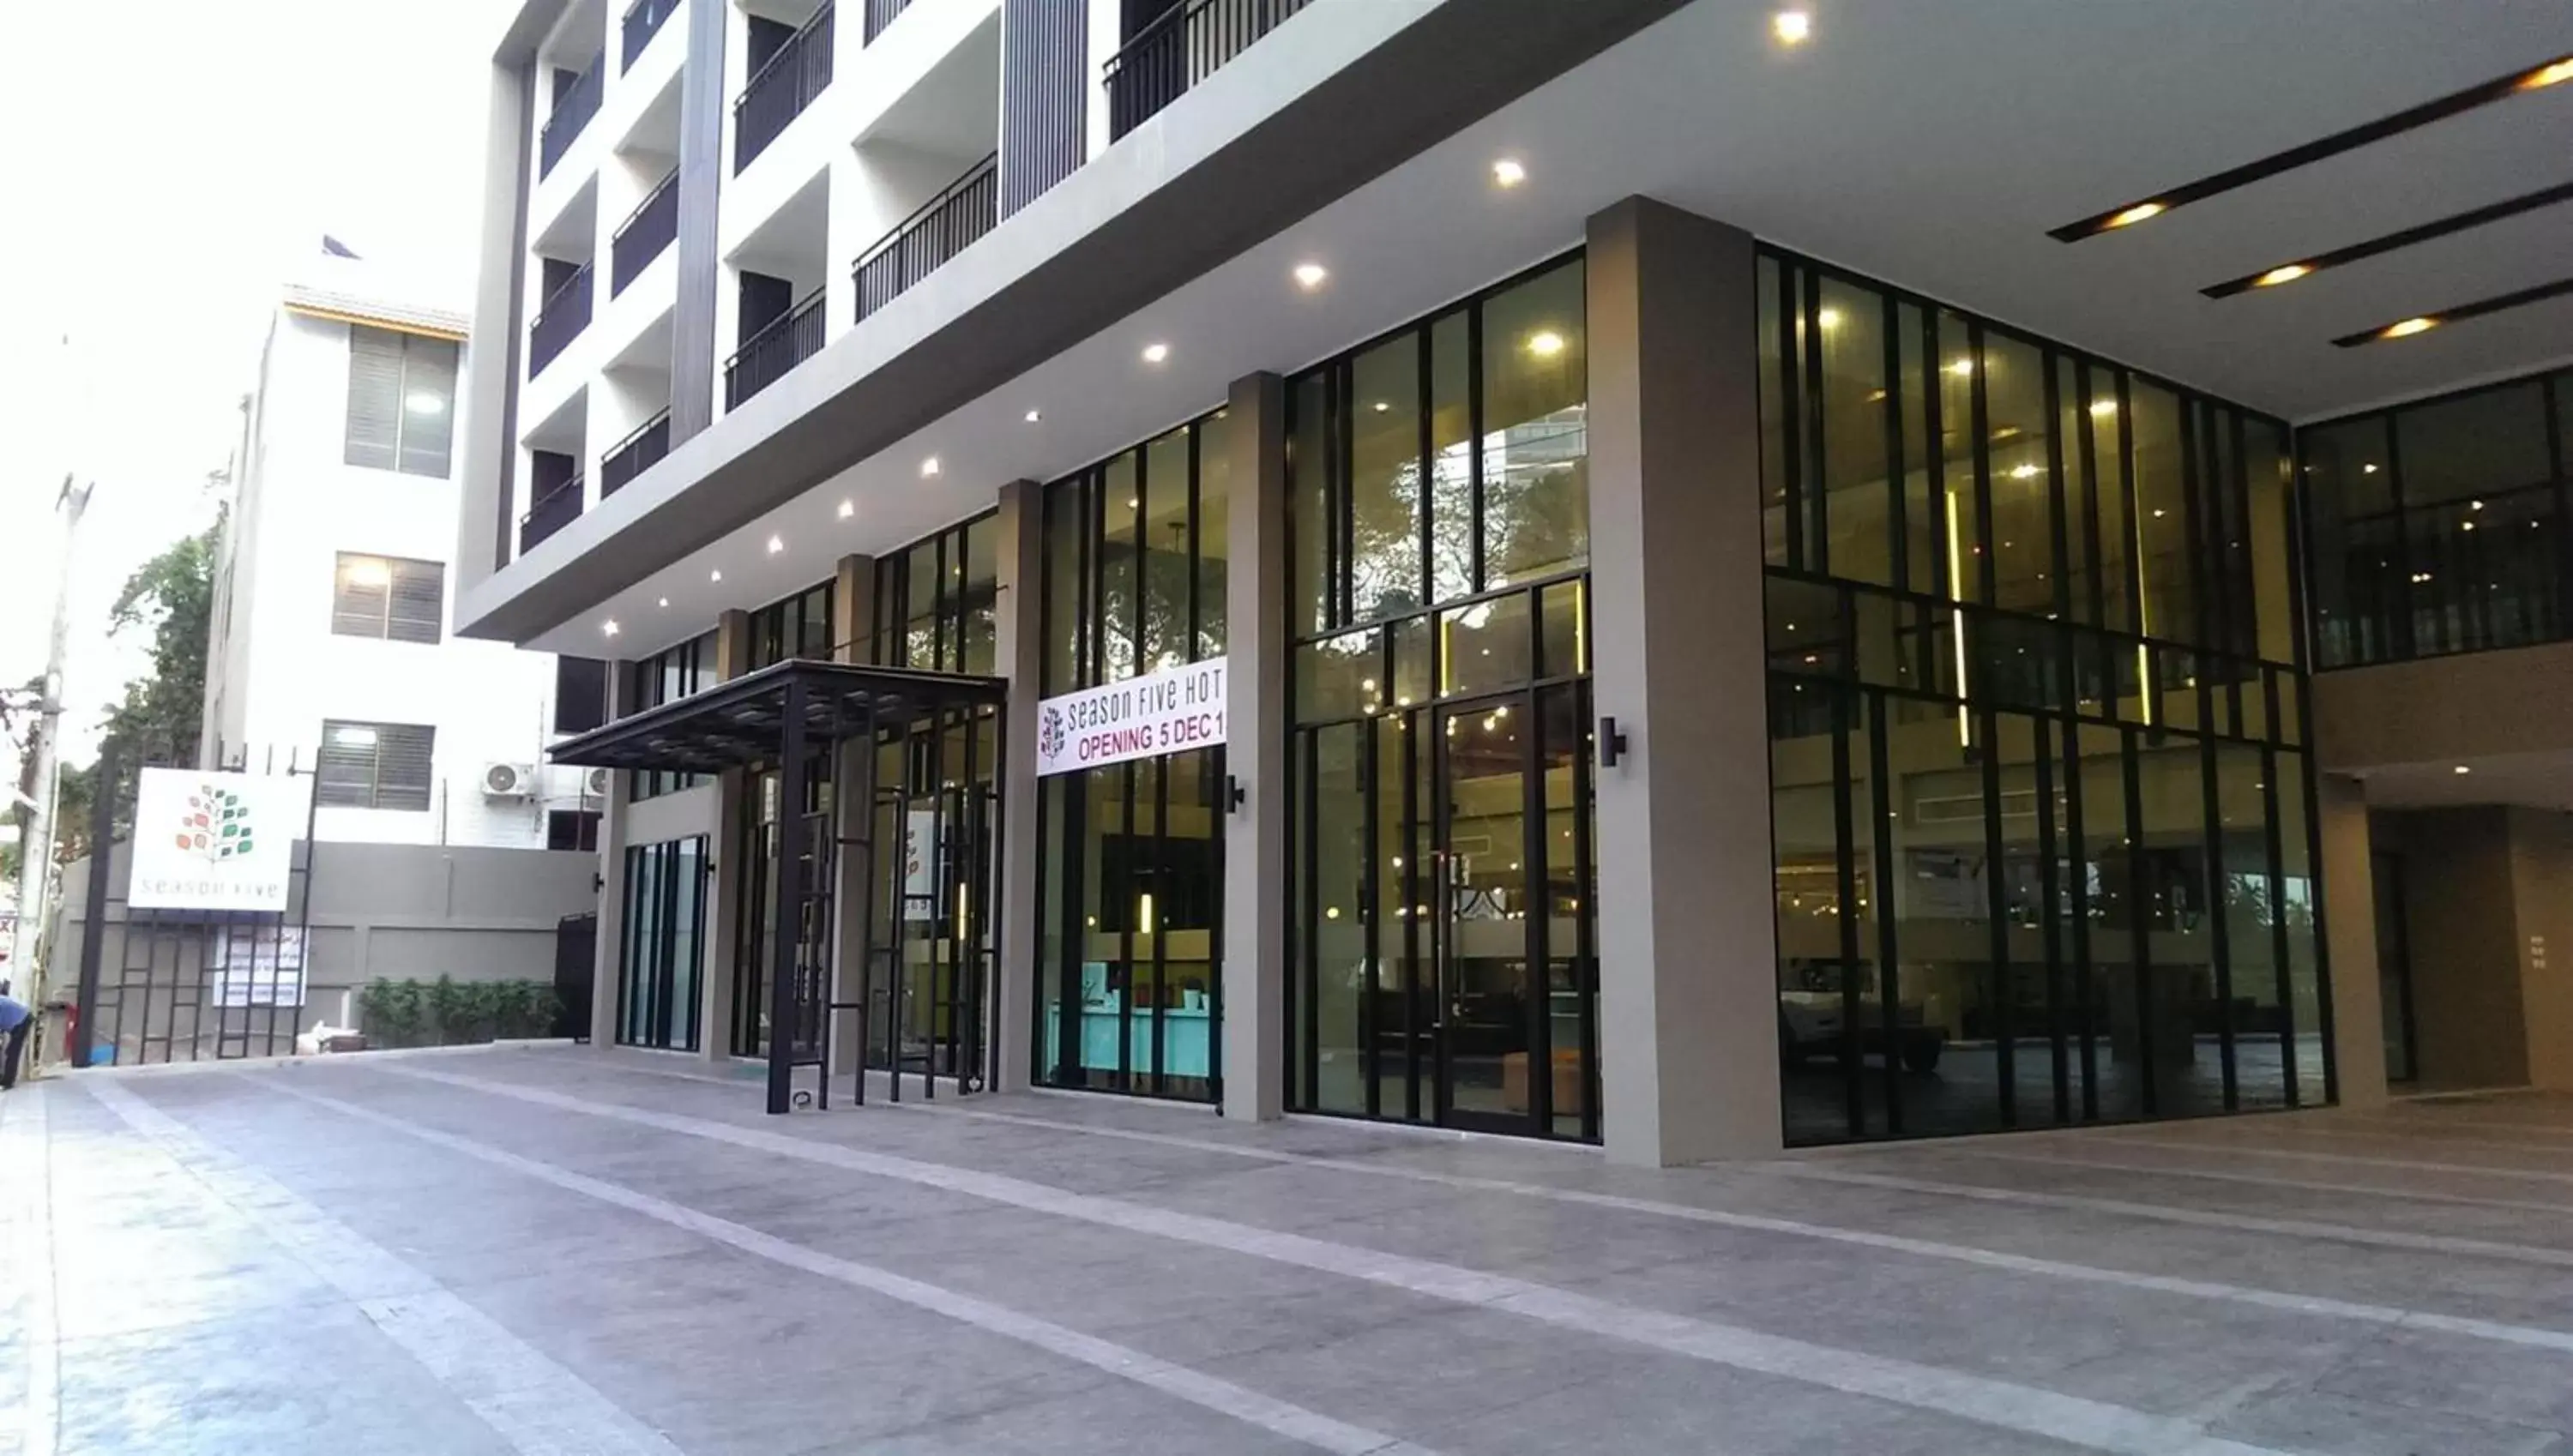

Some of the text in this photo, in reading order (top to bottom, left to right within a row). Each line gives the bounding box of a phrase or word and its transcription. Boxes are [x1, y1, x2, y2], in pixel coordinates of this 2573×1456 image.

[1069, 690, 1131, 731] season
[1186, 669, 1222, 705] HOT
[1079, 725, 1153, 761] OPENING
[1160, 723, 1169, 747] 5
[1174, 713, 1212, 743] DEC
